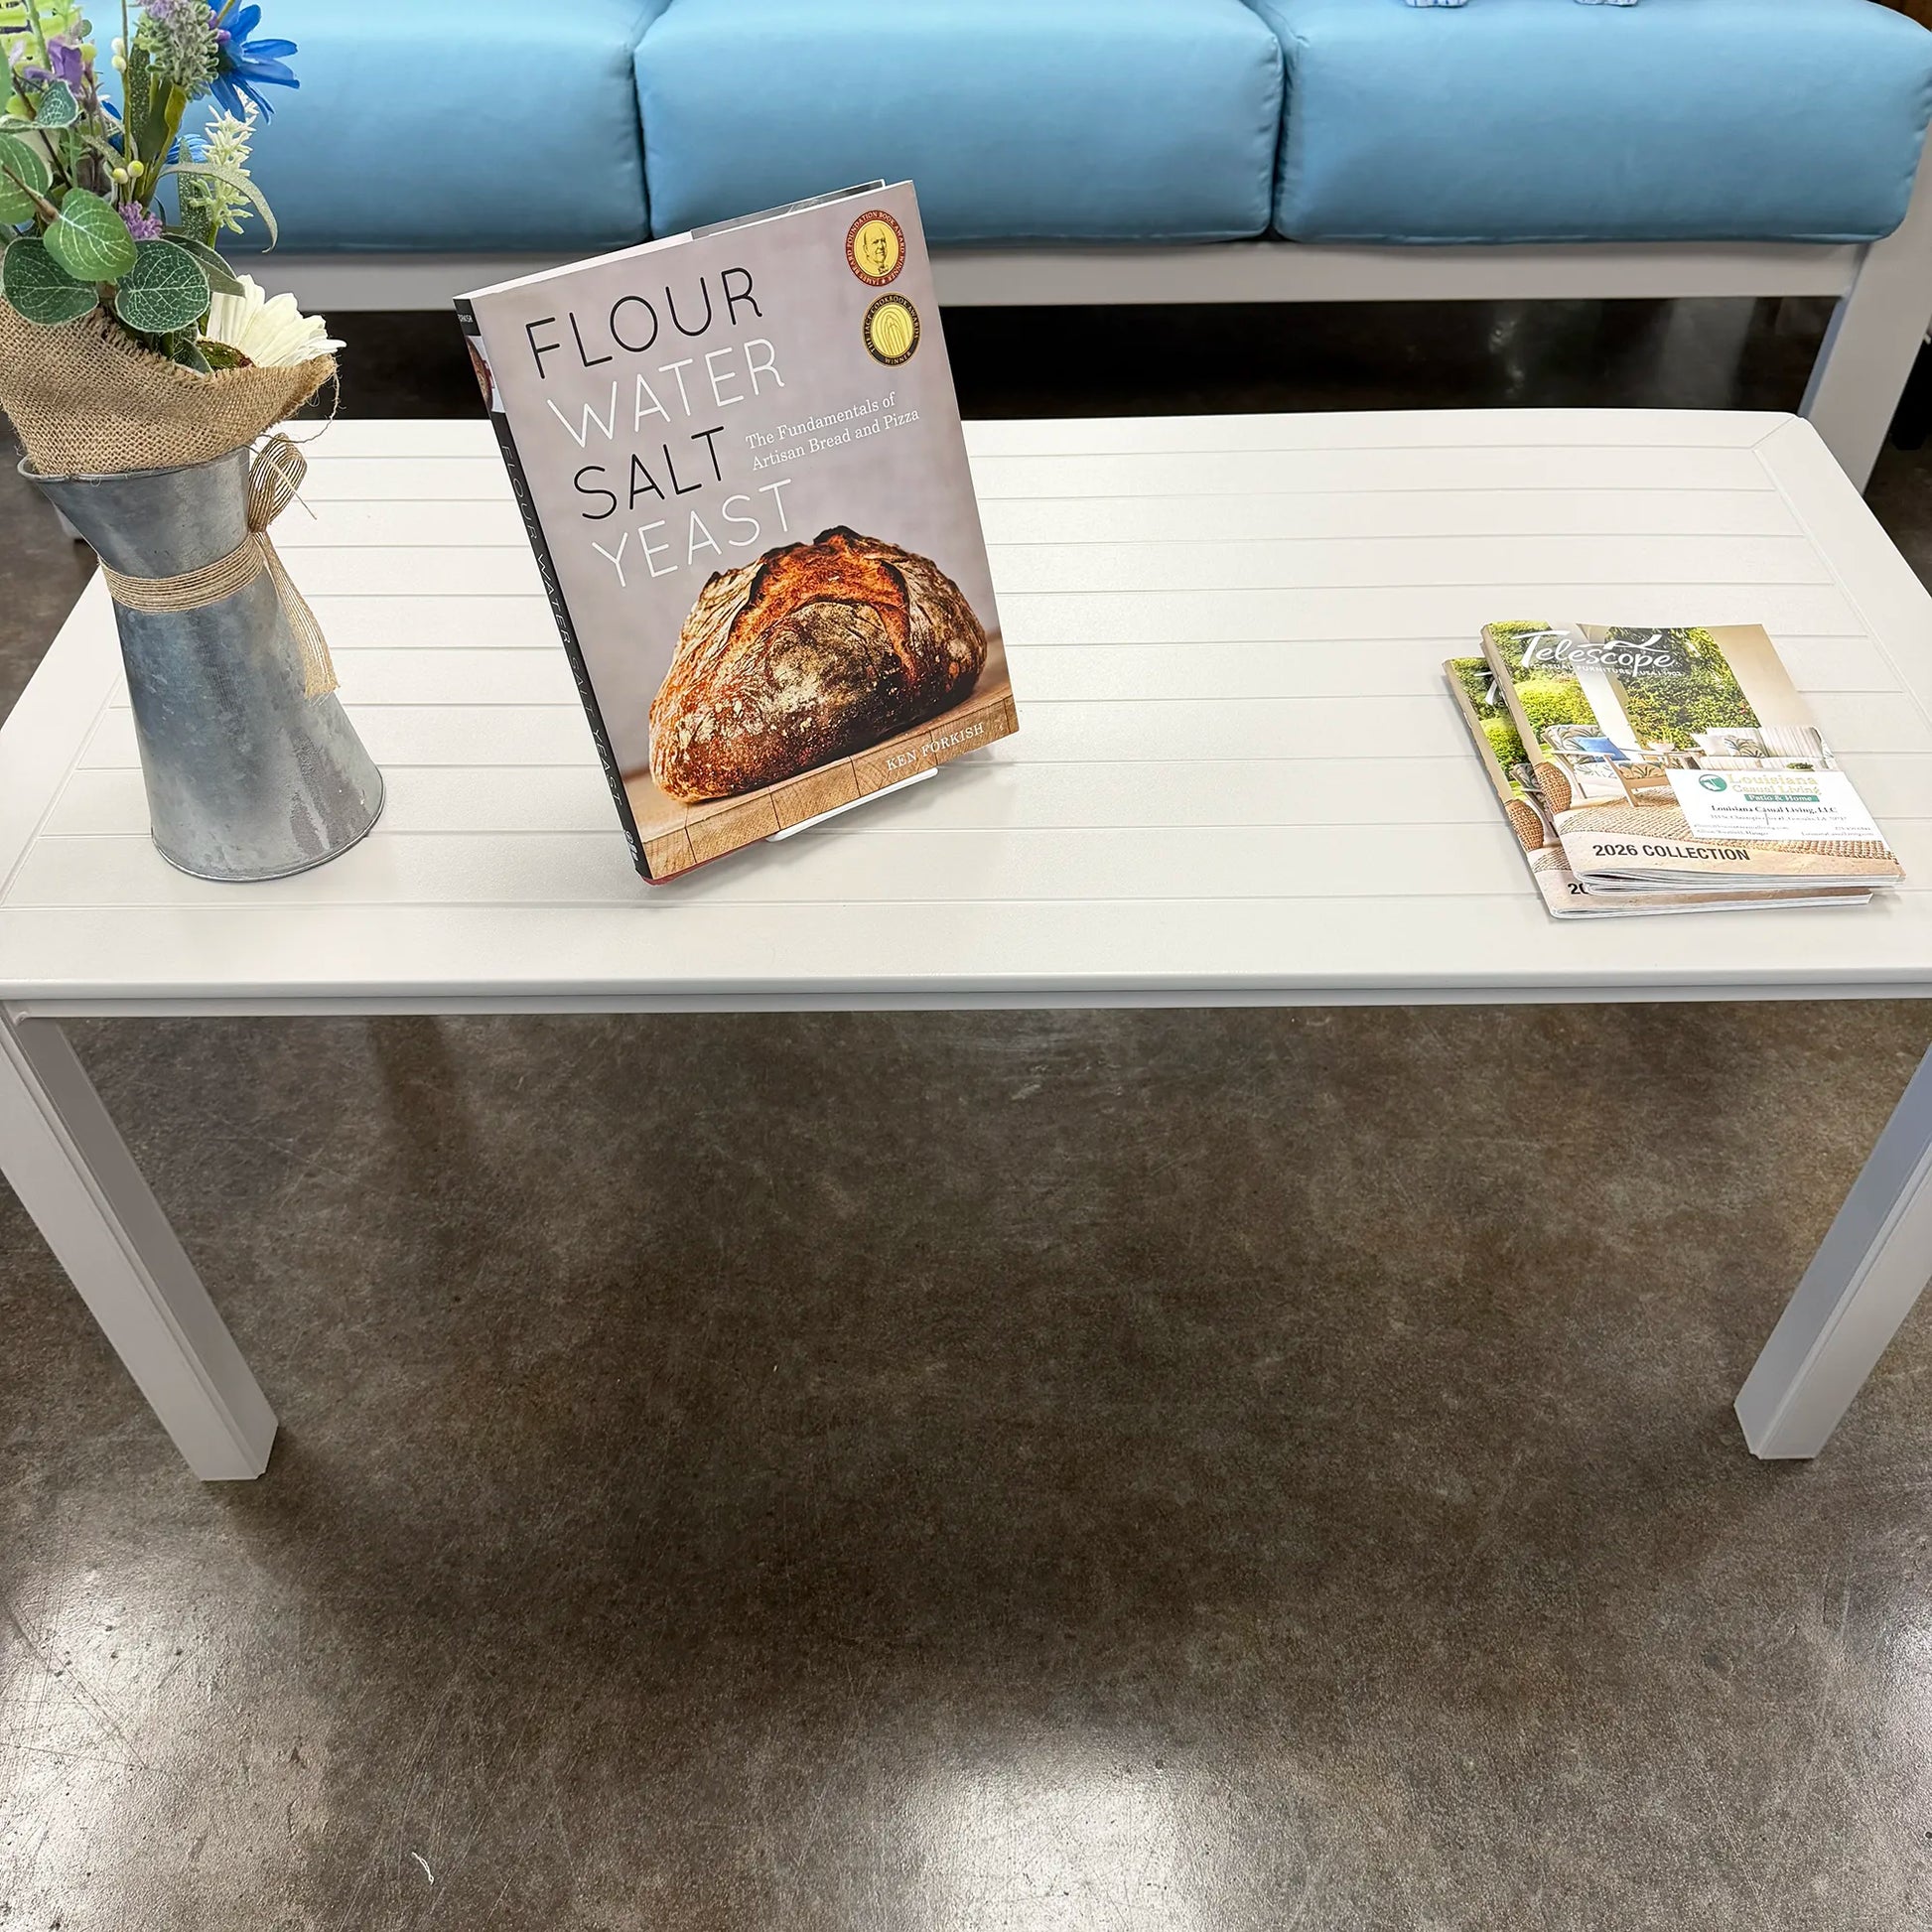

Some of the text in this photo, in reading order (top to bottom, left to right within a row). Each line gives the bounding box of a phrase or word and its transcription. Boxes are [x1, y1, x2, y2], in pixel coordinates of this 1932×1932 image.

[847, 211, 877, 247] FOUNDATION
[893, 223, 904, 253] AWARD
[525, 267, 762, 379] FLOUR
[884, 349, 912, 364] WINNER
[547, 339, 785, 448] WATER
[745, 391, 896, 450] The Fundamentals of
[753, 409, 920, 471] Artisan Bread and Pizza
[574, 426, 724, 519] SALT
[592, 479, 792, 588] YEAST
[501, 445, 623, 806] FLOUR WATER SALT YEAST
[1511, 629, 1676, 678] Telescope
[1577, 665, 1632, 675] FURNITURE
[887, 722, 985, 770] KEN FORKISH
[1727, 773, 1819, 785] Louisiana
[1732, 784, 1823, 795] Casual Living
[1592, 844, 1751, 861] 2026 COLLECTION
